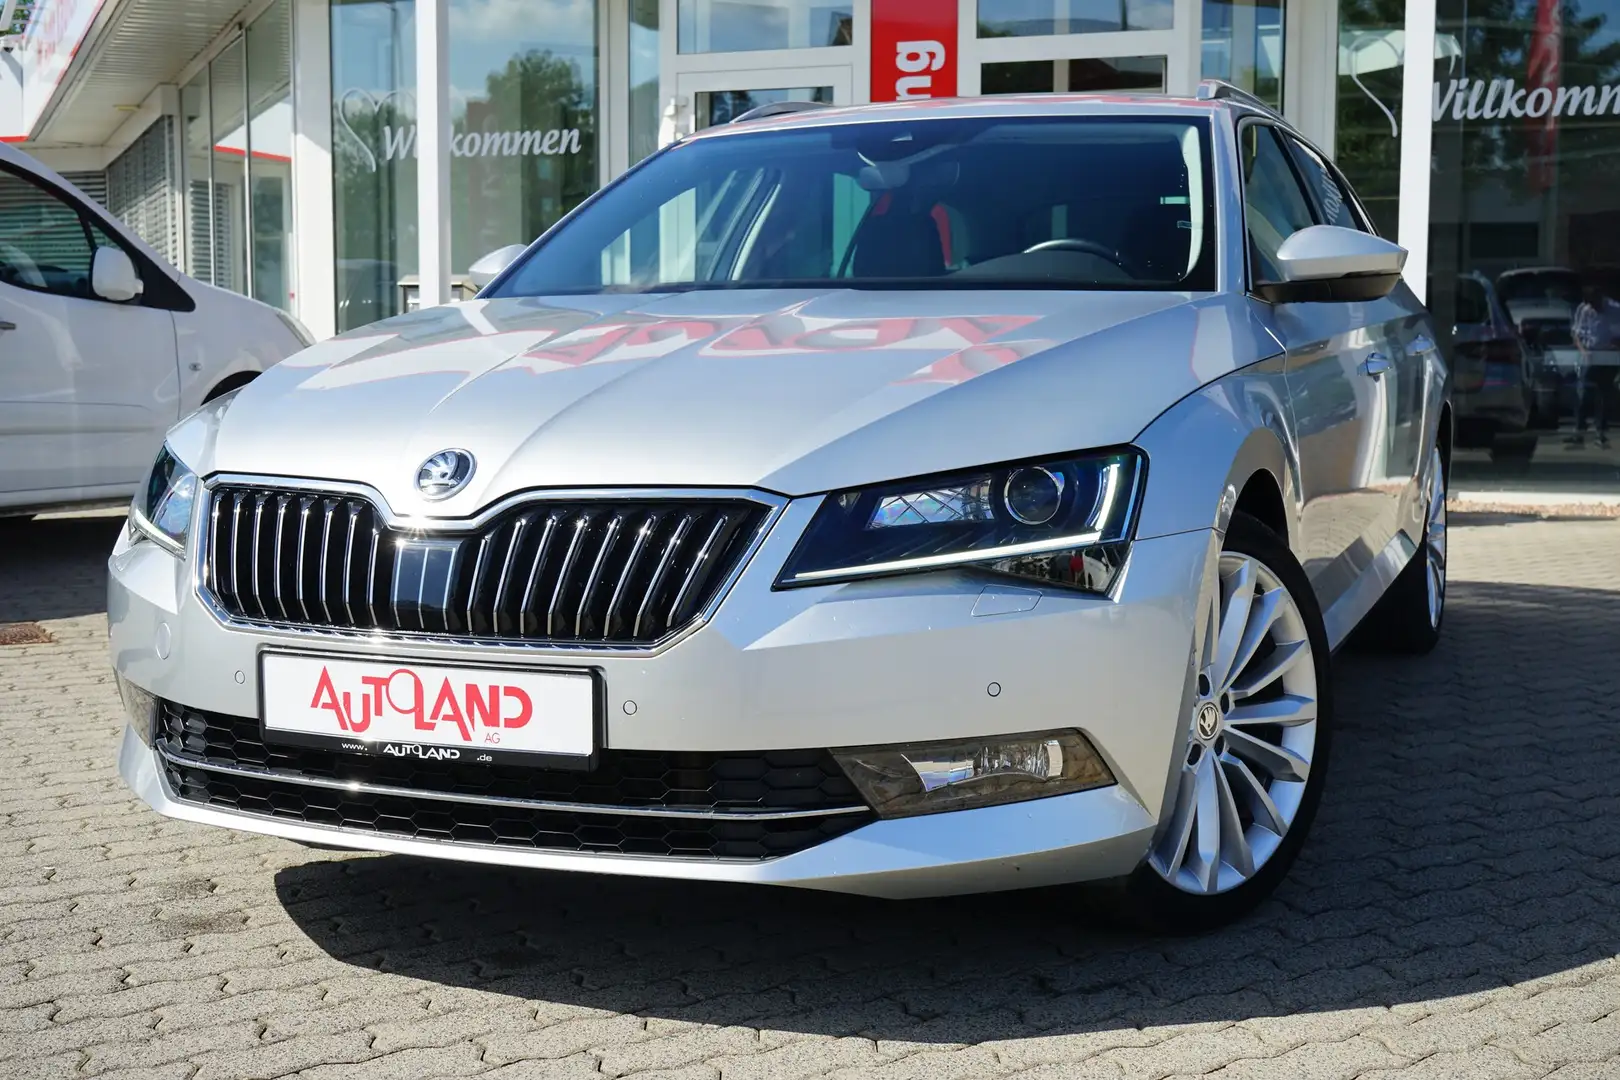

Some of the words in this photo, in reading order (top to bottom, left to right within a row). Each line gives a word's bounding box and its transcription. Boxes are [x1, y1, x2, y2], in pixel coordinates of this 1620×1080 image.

[383, 124, 582, 161] Wkommen
[310, 665, 533, 742] AUTOLAND
[341, 742, 368, 751] www.
[383, 743, 461, 761] AUTOLAND
[476, 754, 493, 762] .de
[484, 732, 501, 744] AG
